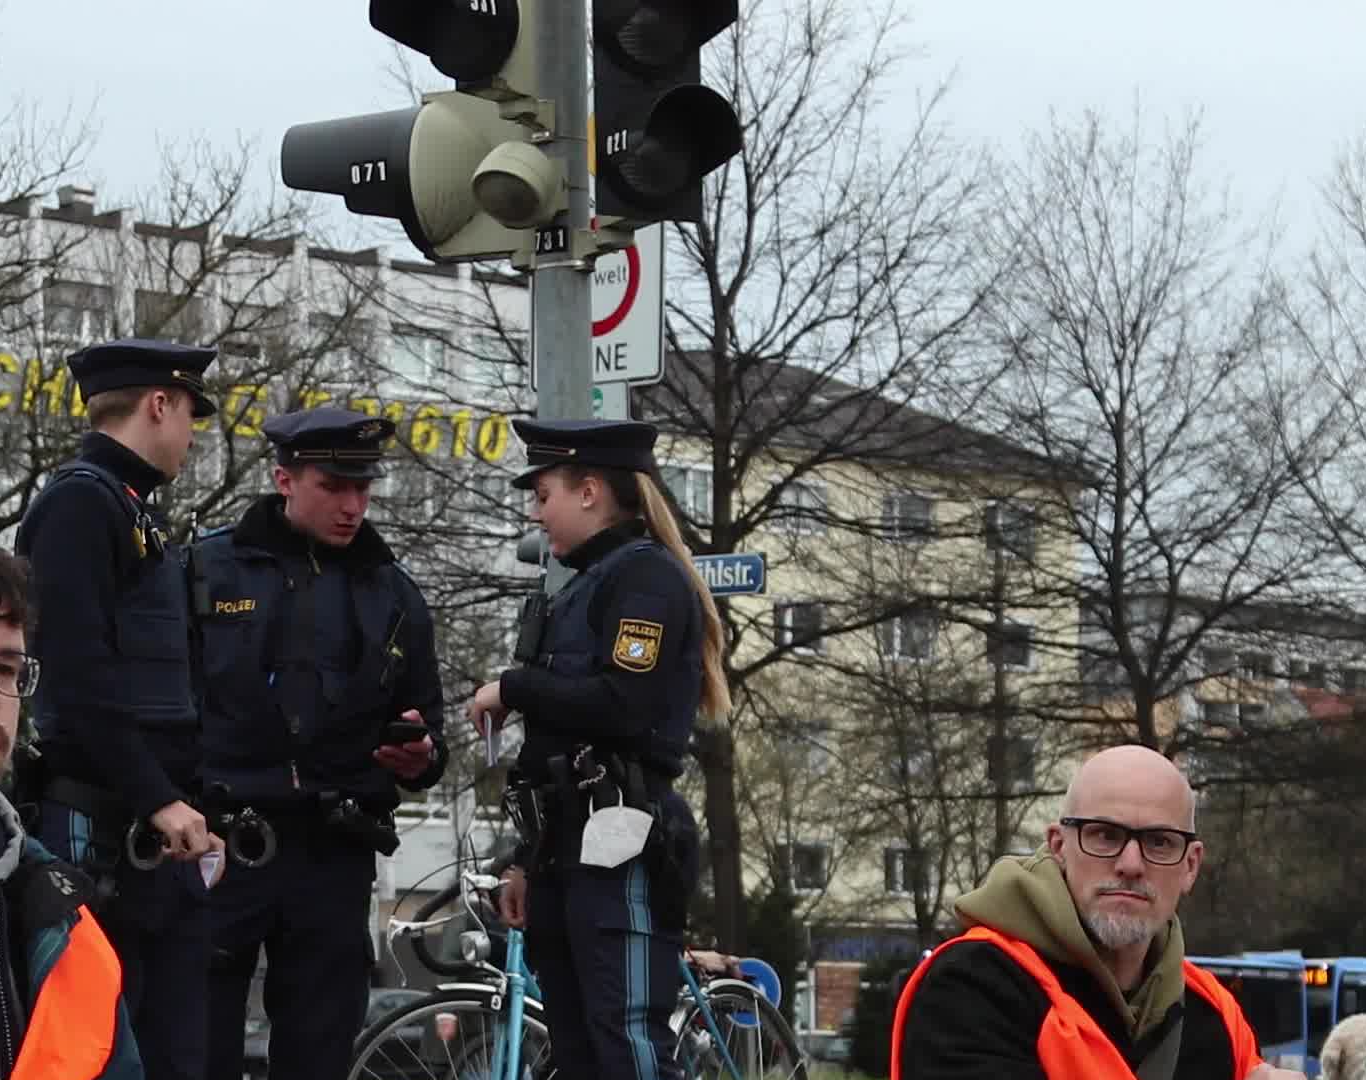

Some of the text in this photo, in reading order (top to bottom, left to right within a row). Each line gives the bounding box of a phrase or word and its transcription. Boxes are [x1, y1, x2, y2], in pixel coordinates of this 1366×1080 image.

[351, 161, 386, 184] 071
[594, 265, 627, 286] welt
[595, 344, 628, 373] NE
[623, 623, 659, 636] POLIZEI
